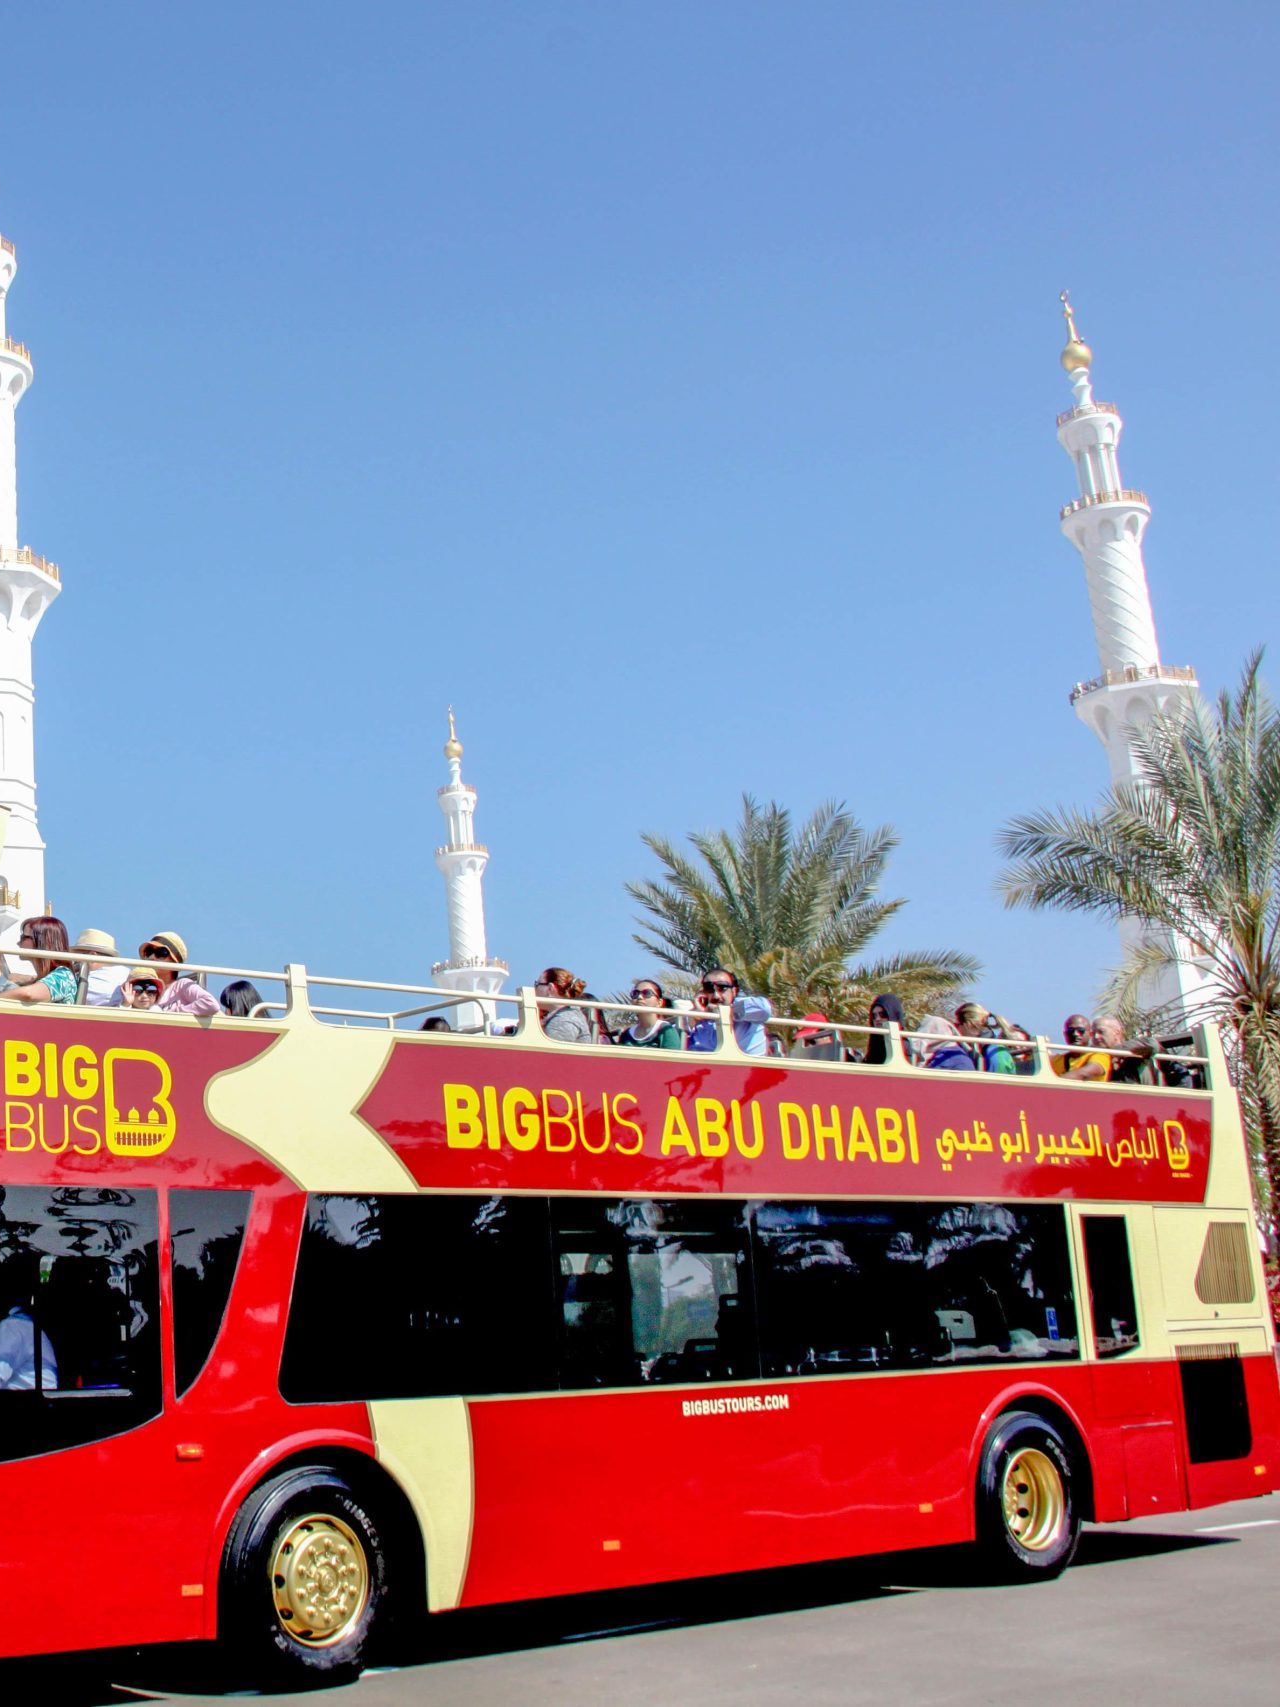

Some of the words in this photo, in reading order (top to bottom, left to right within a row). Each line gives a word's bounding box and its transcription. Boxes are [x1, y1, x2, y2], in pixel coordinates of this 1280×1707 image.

[4, 1040, 99, 1100] BIG
[5, 1101, 101, 1155] BUS
[661, 1096, 765, 1159] ABU
[778, 1102, 920, 1164] DHABI
[935, 1120, 994, 1172] ظبي
[999, 1110, 1031, 1163] أبو
[1035, 1124, 1103, 1164] الكبير
[1106, 1126, 1160, 1168] الباص
[682, 1394, 789, 1416] BIGBUSTOURS.COM
